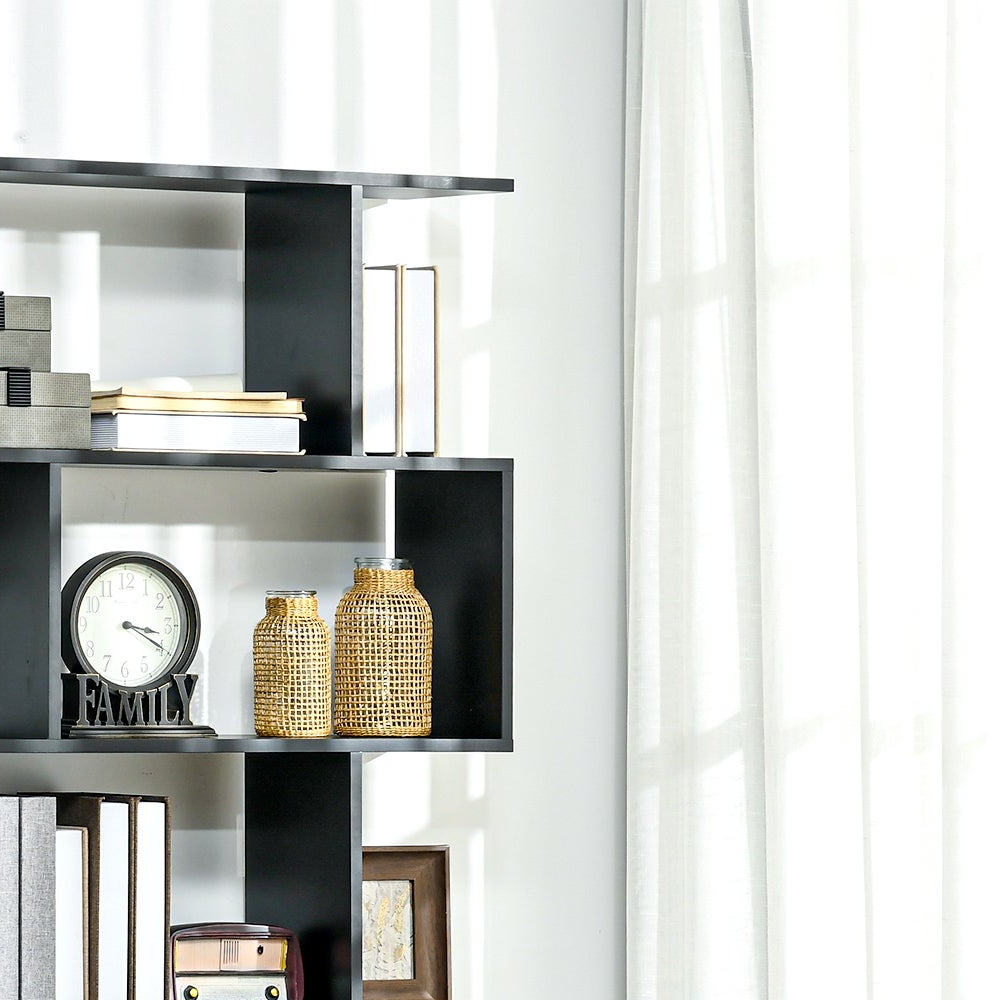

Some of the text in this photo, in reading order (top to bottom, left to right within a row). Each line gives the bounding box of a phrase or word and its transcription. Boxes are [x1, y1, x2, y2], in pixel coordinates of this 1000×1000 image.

[98, 580, 112, 598] 11
[118, 572, 135, 590] 12
[142, 579, 149, 596] 1
[86, 595, 100, 613] 10
[155, 592, 165, 610] 2
[79, 616, 88, 633] 9
[163, 617, 173, 634] 3
[86, 640, 95, 657] 8
[155, 639, 164, 656] 4
[102, 654, 112, 672] 7
[120, 660, 129, 678] 6
[140, 656, 149, 673] 5
[76, 673, 199, 726] FAMILY
